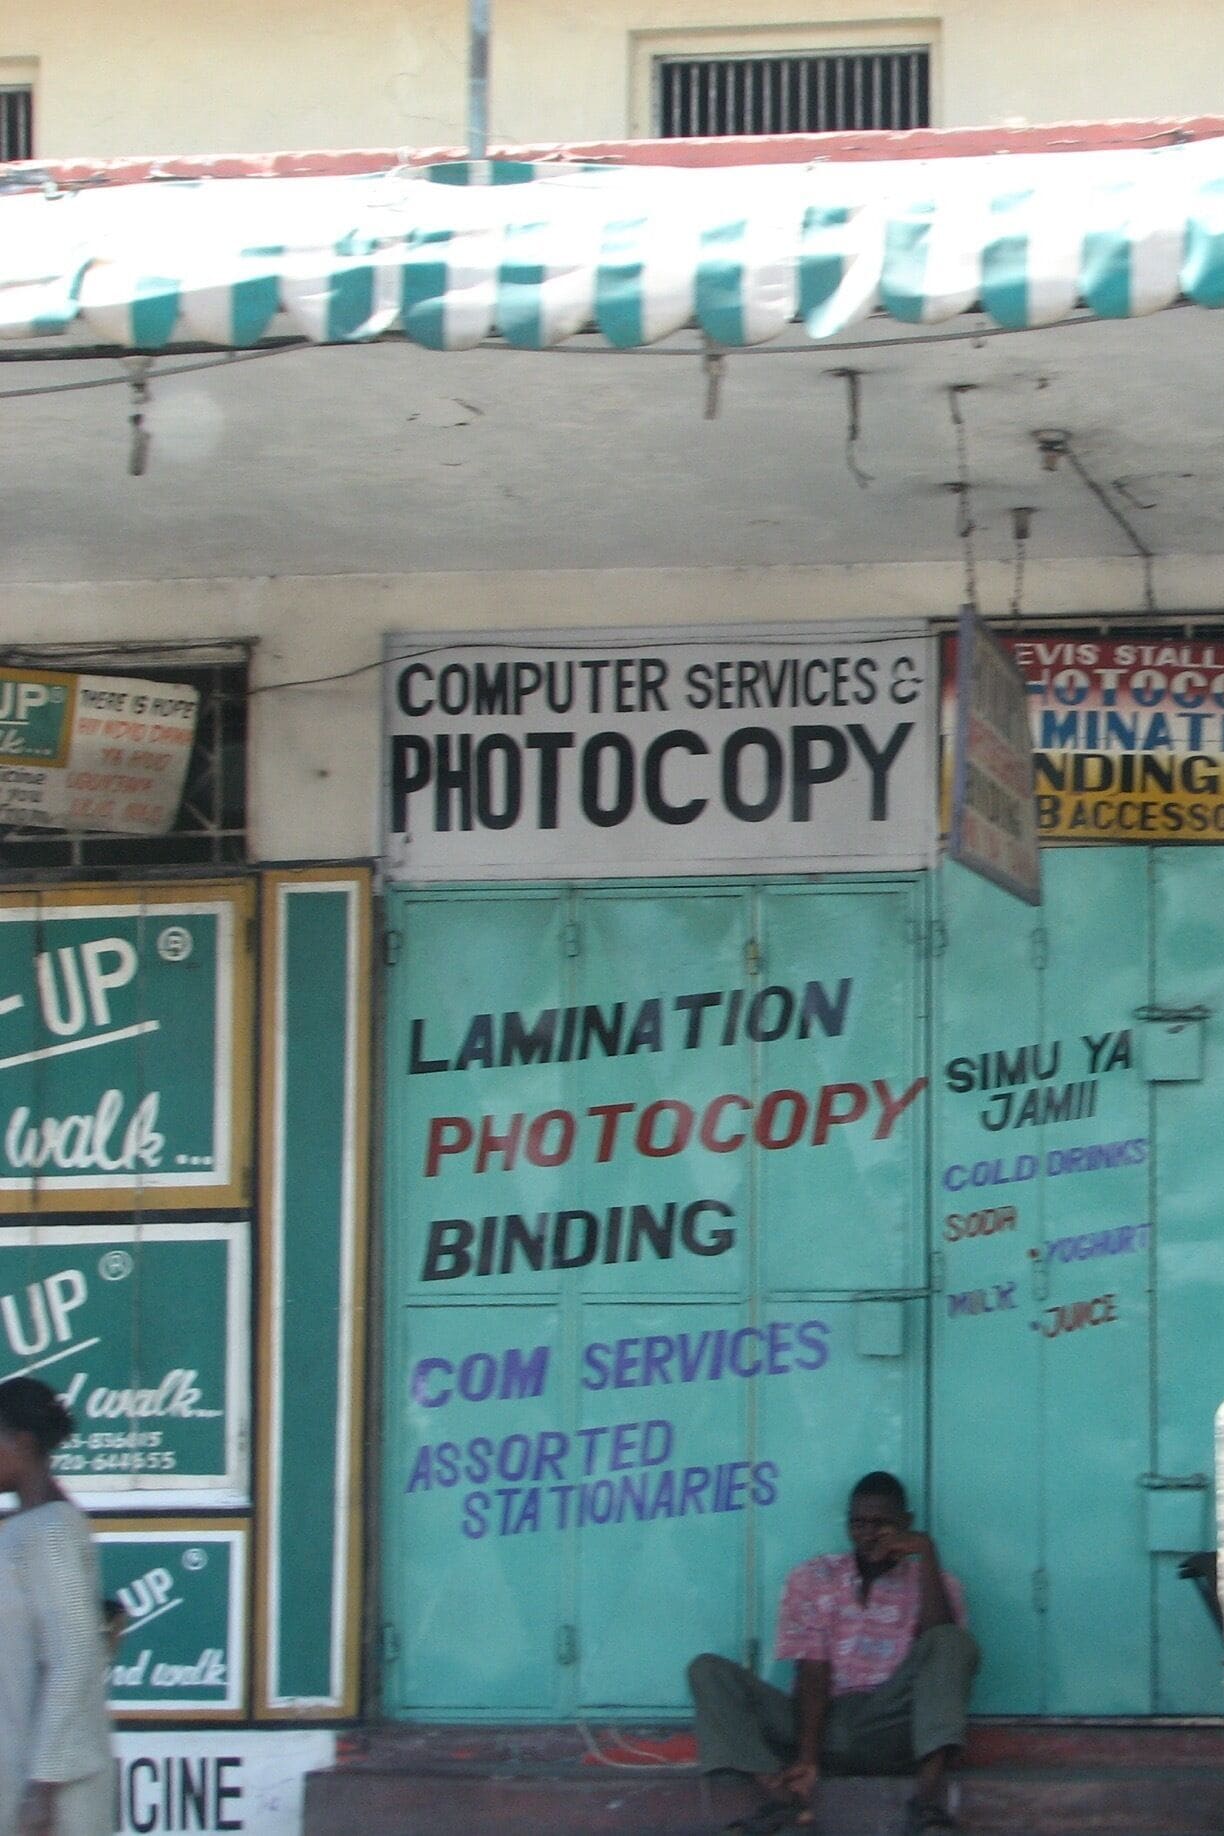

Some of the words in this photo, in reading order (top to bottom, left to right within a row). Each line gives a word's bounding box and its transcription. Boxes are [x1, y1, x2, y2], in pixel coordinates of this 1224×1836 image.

[400, 658, 669, 717] COMPUTER
[684, 657, 878, 709] SERVICES
[1014, 643, 1099, 666] EVIS
[1114, 645, 1224, 668] STALL
[391, 722, 916, 832] PHOTOCOPY
[1032, 753, 1221, 794] NDING
[408, 977, 853, 1075] LAMINATION
[946, 1041, 1060, 1093] SIMU
[1080, 1029, 1133, 1074] YA
[423, 1077, 929, 1177] PHOTOCOPY
[981, 1080, 1098, 1131] JAMII
[944, 1154, 1038, 1191] COLD
[422, 1200, 735, 1281] BINDING
[945, 1205, 1017, 1242] SODA
[1, 1269, 88, 1355] UP
[411, 1347, 550, 1408] COM
[580, 1320, 832, 1392] SERVICES
[405, 1419, 674, 1493] ASSORTED
[462, 1461, 779, 1540] STATIONARIES
[117, 1567, 173, 1617] UP
